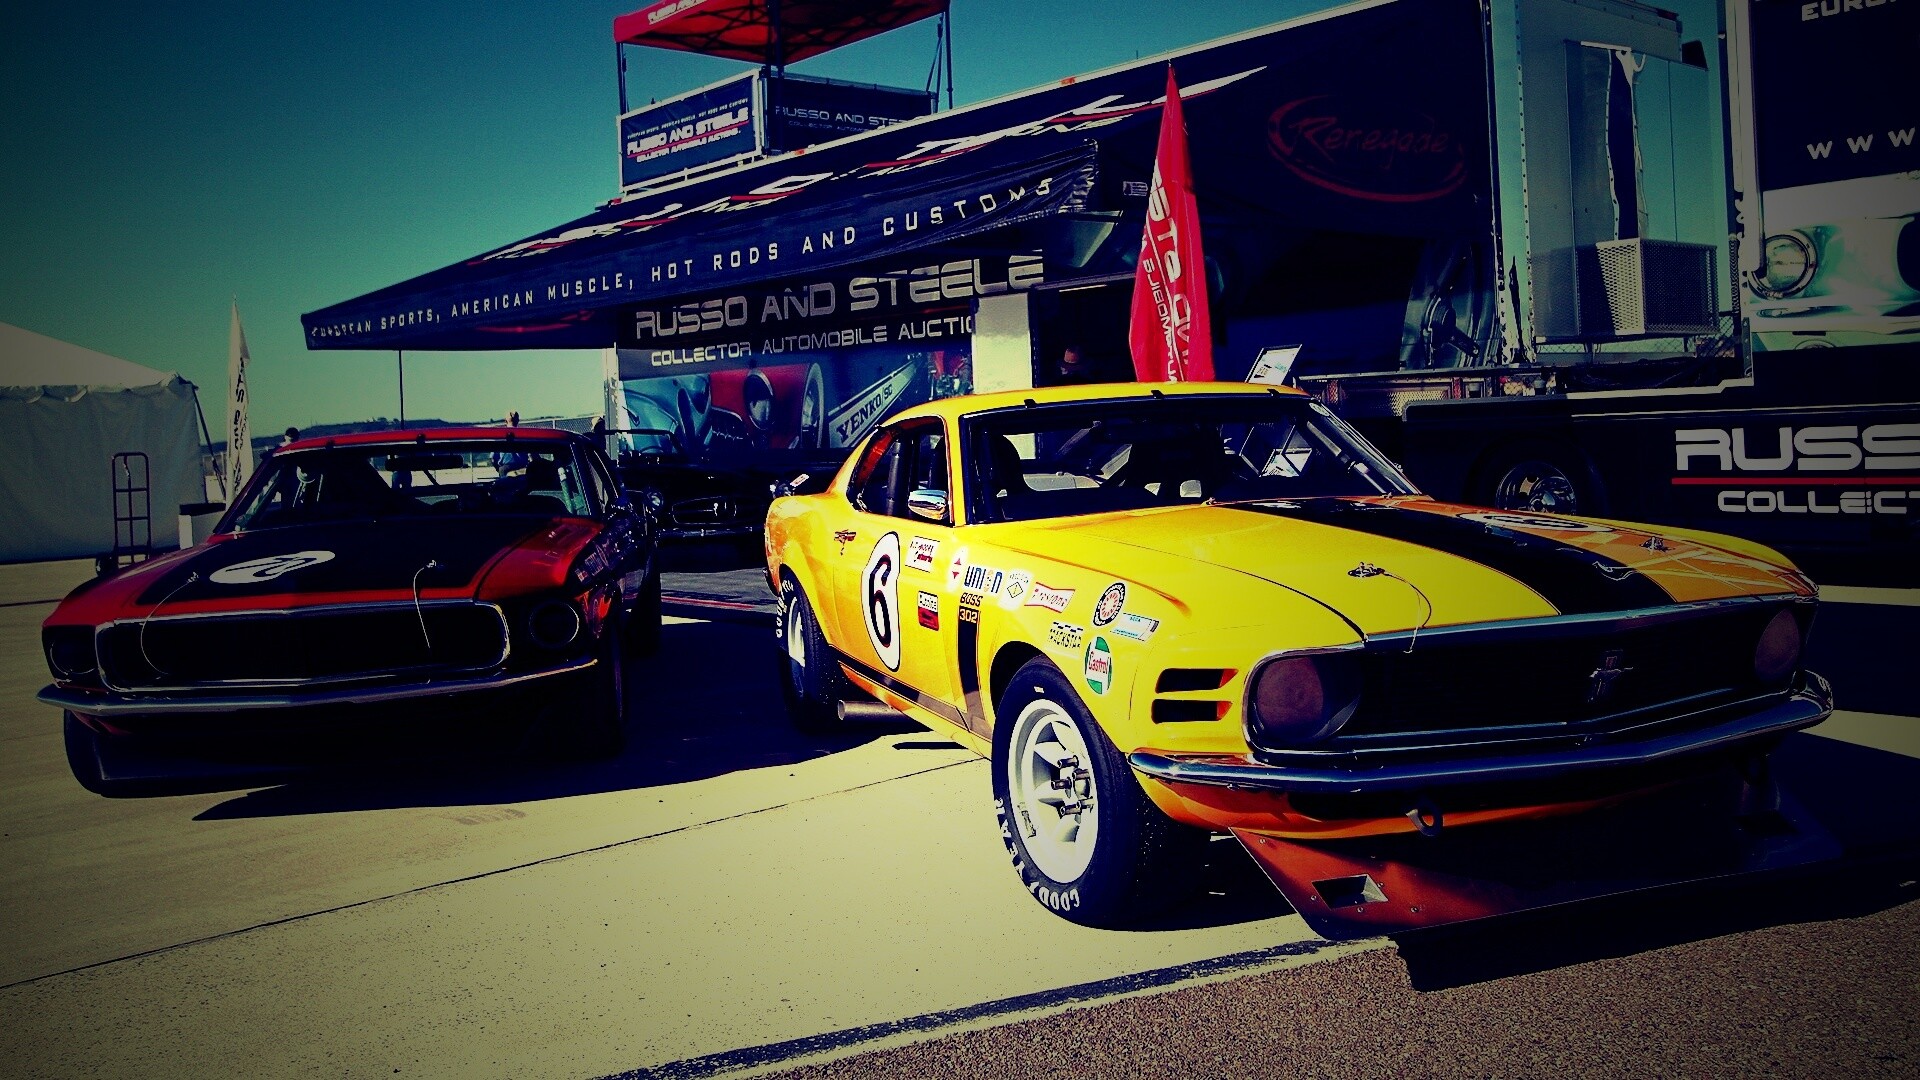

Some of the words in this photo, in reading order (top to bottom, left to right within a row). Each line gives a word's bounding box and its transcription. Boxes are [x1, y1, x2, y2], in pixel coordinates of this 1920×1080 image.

[834, 112, 865, 125] AND
[1286, 112, 1453, 174] Renegade
[380, 308, 440, 331] SPORTS,
[451, 289, 534, 318] AMERICAN
[547, 272, 634, 301] MUSCLE,
[651, 258, 694, 284] HOT
[713, 243, 778, 271] RODS
[802, 226, 856, 254] AND
[882, 177, 1054, 237] CUSTOMS
[636, 294, 748, 340] RUSSO
[761, 280, 837, 324] AND
[850, 248, 1045, 312] STEELE
[651, 341, 752, 367] COLLECTOR
[762, 325, 888, 355] AUTOMOBILE
[836, 393, 882, 444] YENKO
[1675, 423, 1920, 471] RUSS
[868, 554, 893, 647] 6
[959, 608, 979, 624] 302
[960, 592, 983, 607] BOSS
[1088, 651, 1109, 675] Castrol
